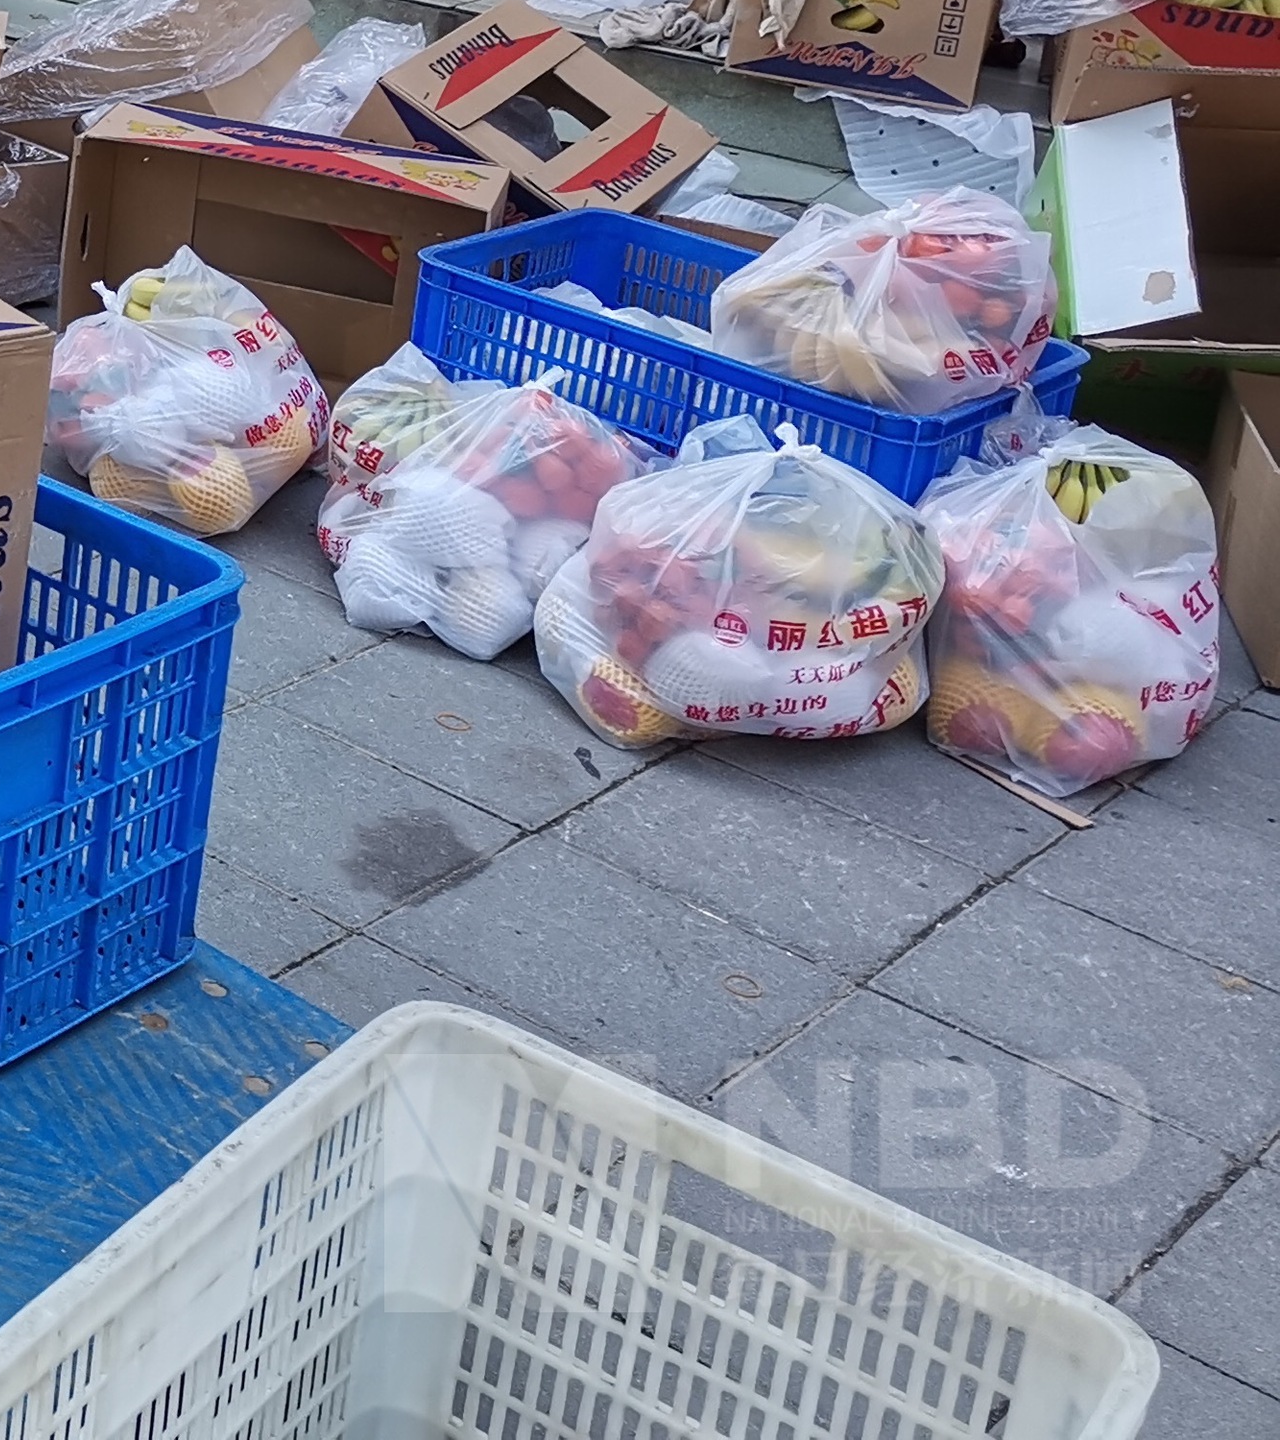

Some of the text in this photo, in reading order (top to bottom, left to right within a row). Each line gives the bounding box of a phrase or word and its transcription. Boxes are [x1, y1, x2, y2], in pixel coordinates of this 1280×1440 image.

[1162, 5, 1280, 37] anas
[428, 23, 516, 81] Bananas
[591, 142, 677, 202] Bananas
[767, 593, 928, 652] 丽红超市
[683, 694, 828, 723] 做您身边的
